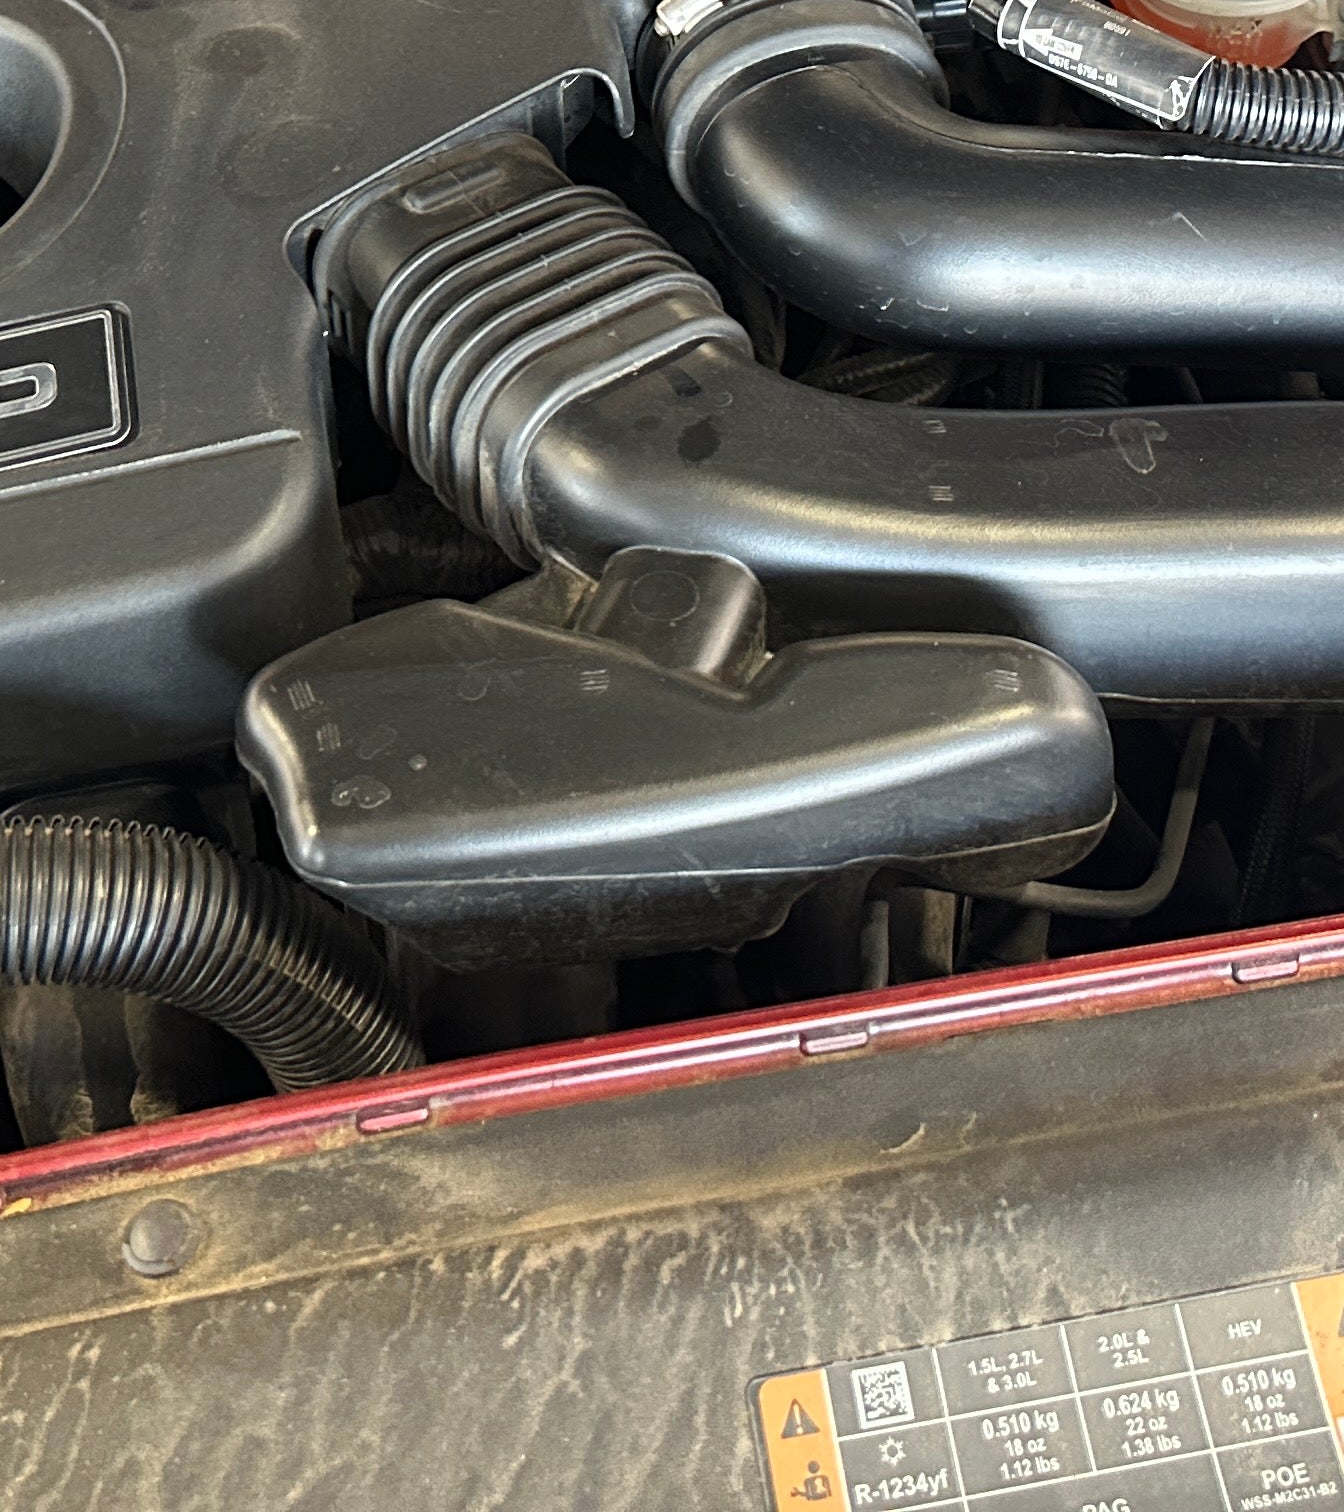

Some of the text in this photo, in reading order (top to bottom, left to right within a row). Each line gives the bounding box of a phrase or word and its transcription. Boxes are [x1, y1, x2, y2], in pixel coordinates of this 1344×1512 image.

[1097, 1328, 1150, 1353] 2.0L &
[1227, 1318, 1263, 1339] HEV
[967, 1349, 1044, 1377] 1.5L, 2.7L
[1112, 1348, 1150, 1368] 2.5L
[987, 1373, 1038, 1393] & 3.0L
[1221, 1367, 1297, 1396] 0.510 kg
[1103, 1389, 1180, 1419] 0.624 kg
[1244, 1393, 1286, 1414] 18 oz
[982, 1409, 1060, 1439] 0.510 kg
[1125, 1415, 1168, 1437] 22 oz
[1241, 1410, 1299, 1434] 1.12 lbs
[1004, 1438, 1047, 1457] 18 oz
[1121, 1434, 1182, 1458] 1.38 lbs
[998, 1455, 1060, 1480] 1.12 lbs
[1260, 1462, 1311, 1490] POE
[854, 1468, 949, 1505] R-1234yf
[1240, 1481, 1338, 1511] WSS-M2C31-B2
